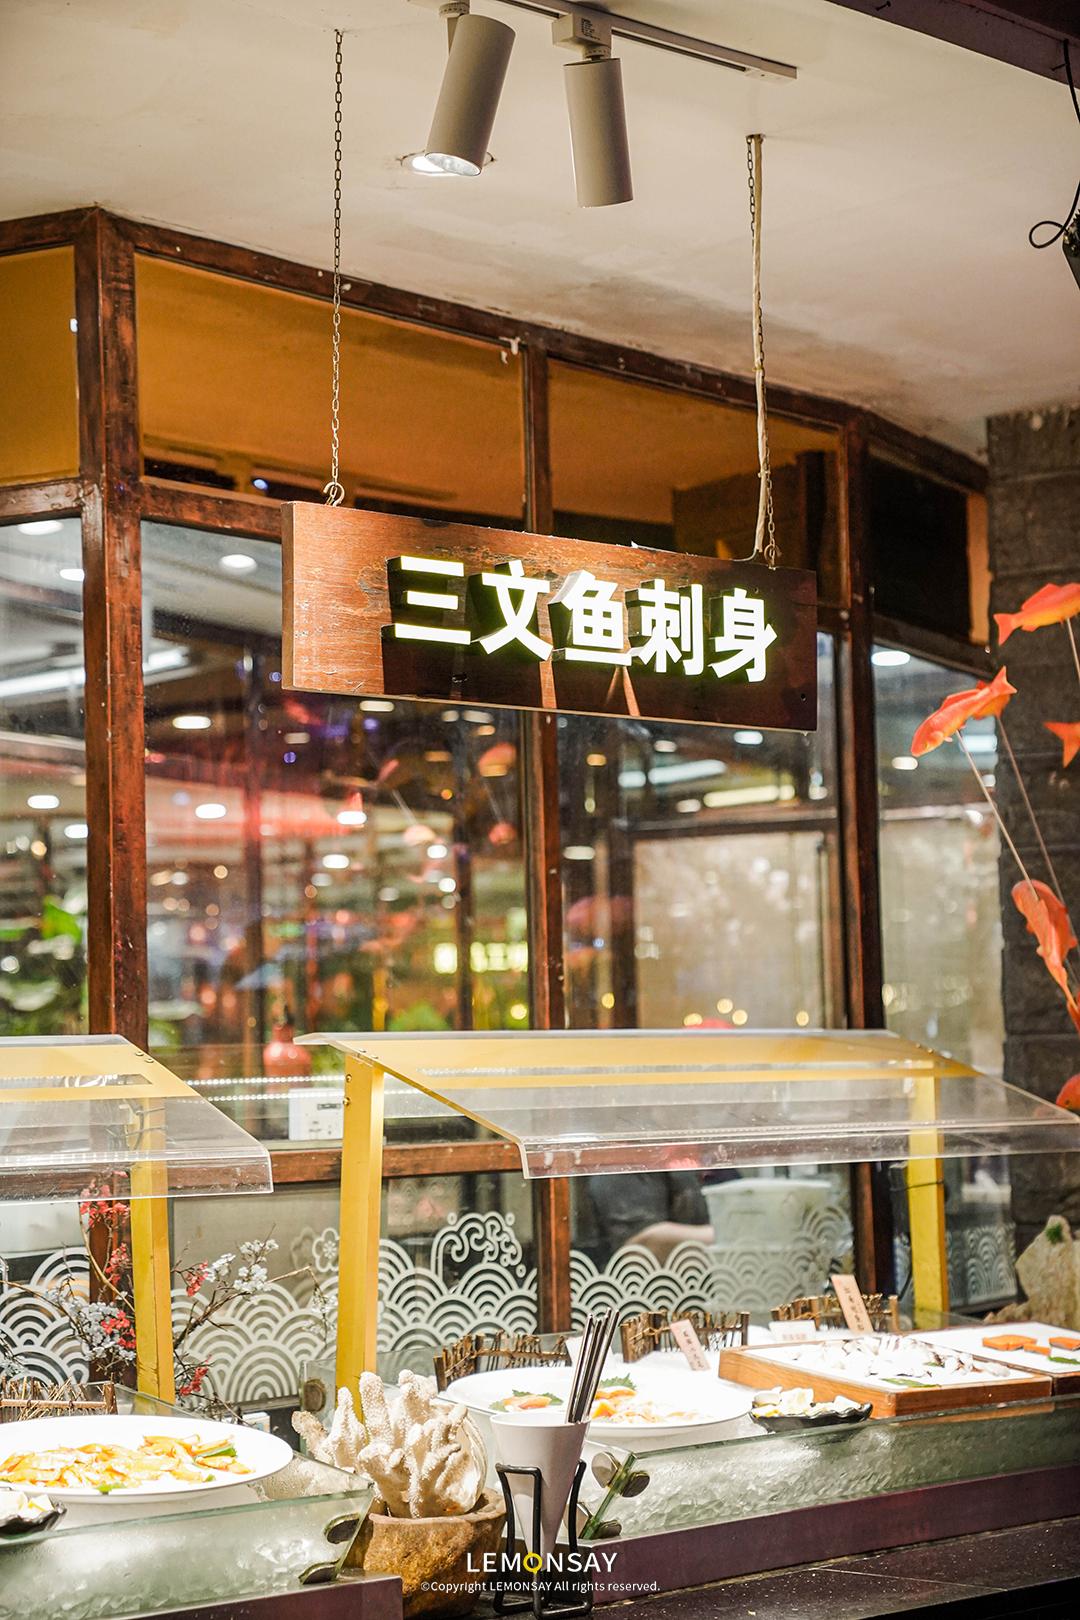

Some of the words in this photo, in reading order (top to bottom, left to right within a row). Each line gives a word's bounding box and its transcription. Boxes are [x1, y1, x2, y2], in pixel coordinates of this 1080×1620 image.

[394, 555, 778, 683] 三文鱼刺身
